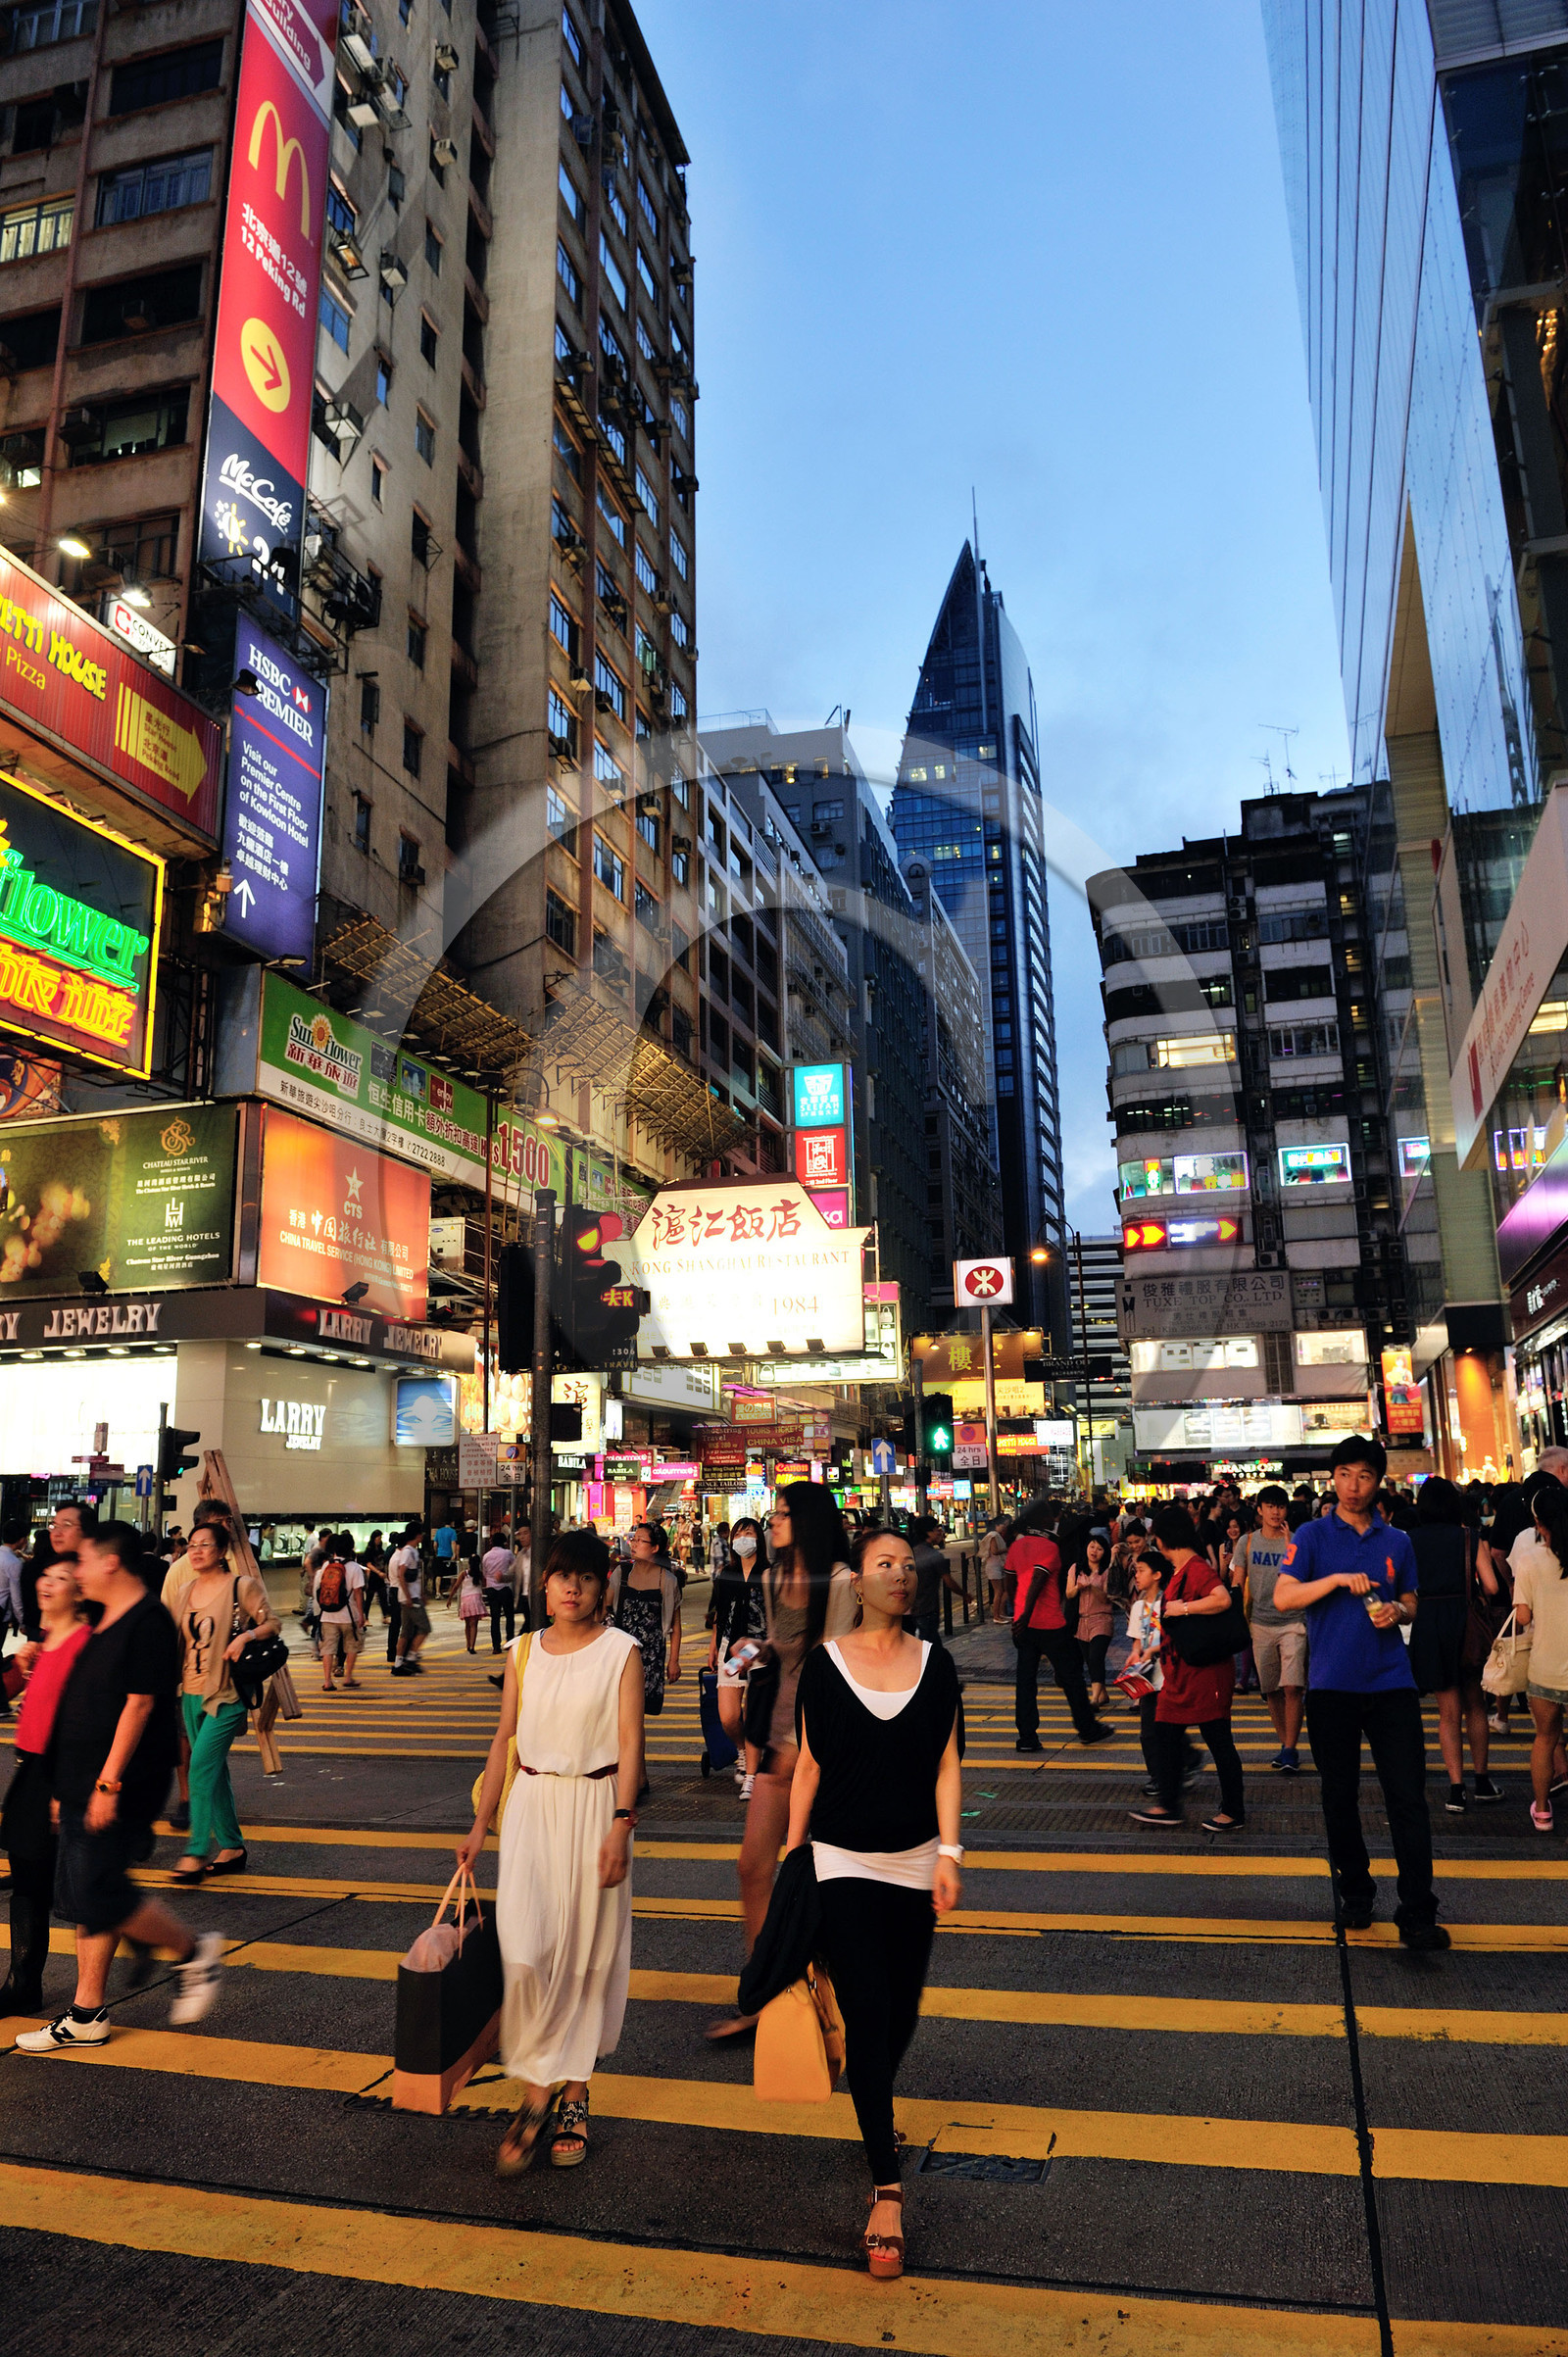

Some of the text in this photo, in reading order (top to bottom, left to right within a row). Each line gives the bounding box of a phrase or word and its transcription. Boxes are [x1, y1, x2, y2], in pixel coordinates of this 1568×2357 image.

[241, 225, 306, 319] 12 Peking Rd
[6, 645, 46, 690] Pizza
[48, 630, 108, 702] HOUSE
[248, 643, 291, 697] HSBC
[255, 679, 313, 748] REMIER
[243, 740, 277, 776] Visit our
[242, 757, 301, 811] Premier Centre
[241, 775, 308, 831] on the First Floor
[240, 791, 308, 848] of Kowloon Hotel
[287, 1043, 358, 1090] 新華旅遊
[142, 1159, 172, 1170] CHATEAU
[344, 1201, 363, 1219] CTS
[146, 1235, 184, 1245] LEADING
[186, 1232, 220, 1242] HOTELS
[289, 1208, 307, 1229] 香港
[380, 1239, 409, 1261] 有限公司
[651, 1199, 802, 1252] 滬江飯店
[280, 1230, 414, 1280] CHINA TRAVEL SERVICE (HONG KONG) LIMITED
[632, 1260, 671, 1276] KONG
[1143, 1275, 1285, 1299] 俊雅禮服有限公司
[1143, 1297, 1183, 1308] TUXE
[1190, 1295, 1217, 1305] TOP
[1254, 1291, 1286, 1302] LTD.
[772, 1295, 819, 1315] 1984
[43, 1302, 163, 1339] JEWELRY
[318, 1309, 443, 1359] LARRY JEWELRY
[261, 1398, 326, 1436] LARRY
[775, 1424, 804, 1433] TICKETS
[285, 1434, 321, 1451] JEWELRY
[747, 1436, 804, 1447] CHINA VISA
[775, 1463, 809, 1473] Canon
[959, 1455, 981, 1466] 全日
[1213, 1462, 1284, 1474] BRAND OFF
[503, 1473, 521, 1482] 全日
[775, 1473, 809, 1485] Nikon
[1252, 1551, 1285, 1566] NAV
